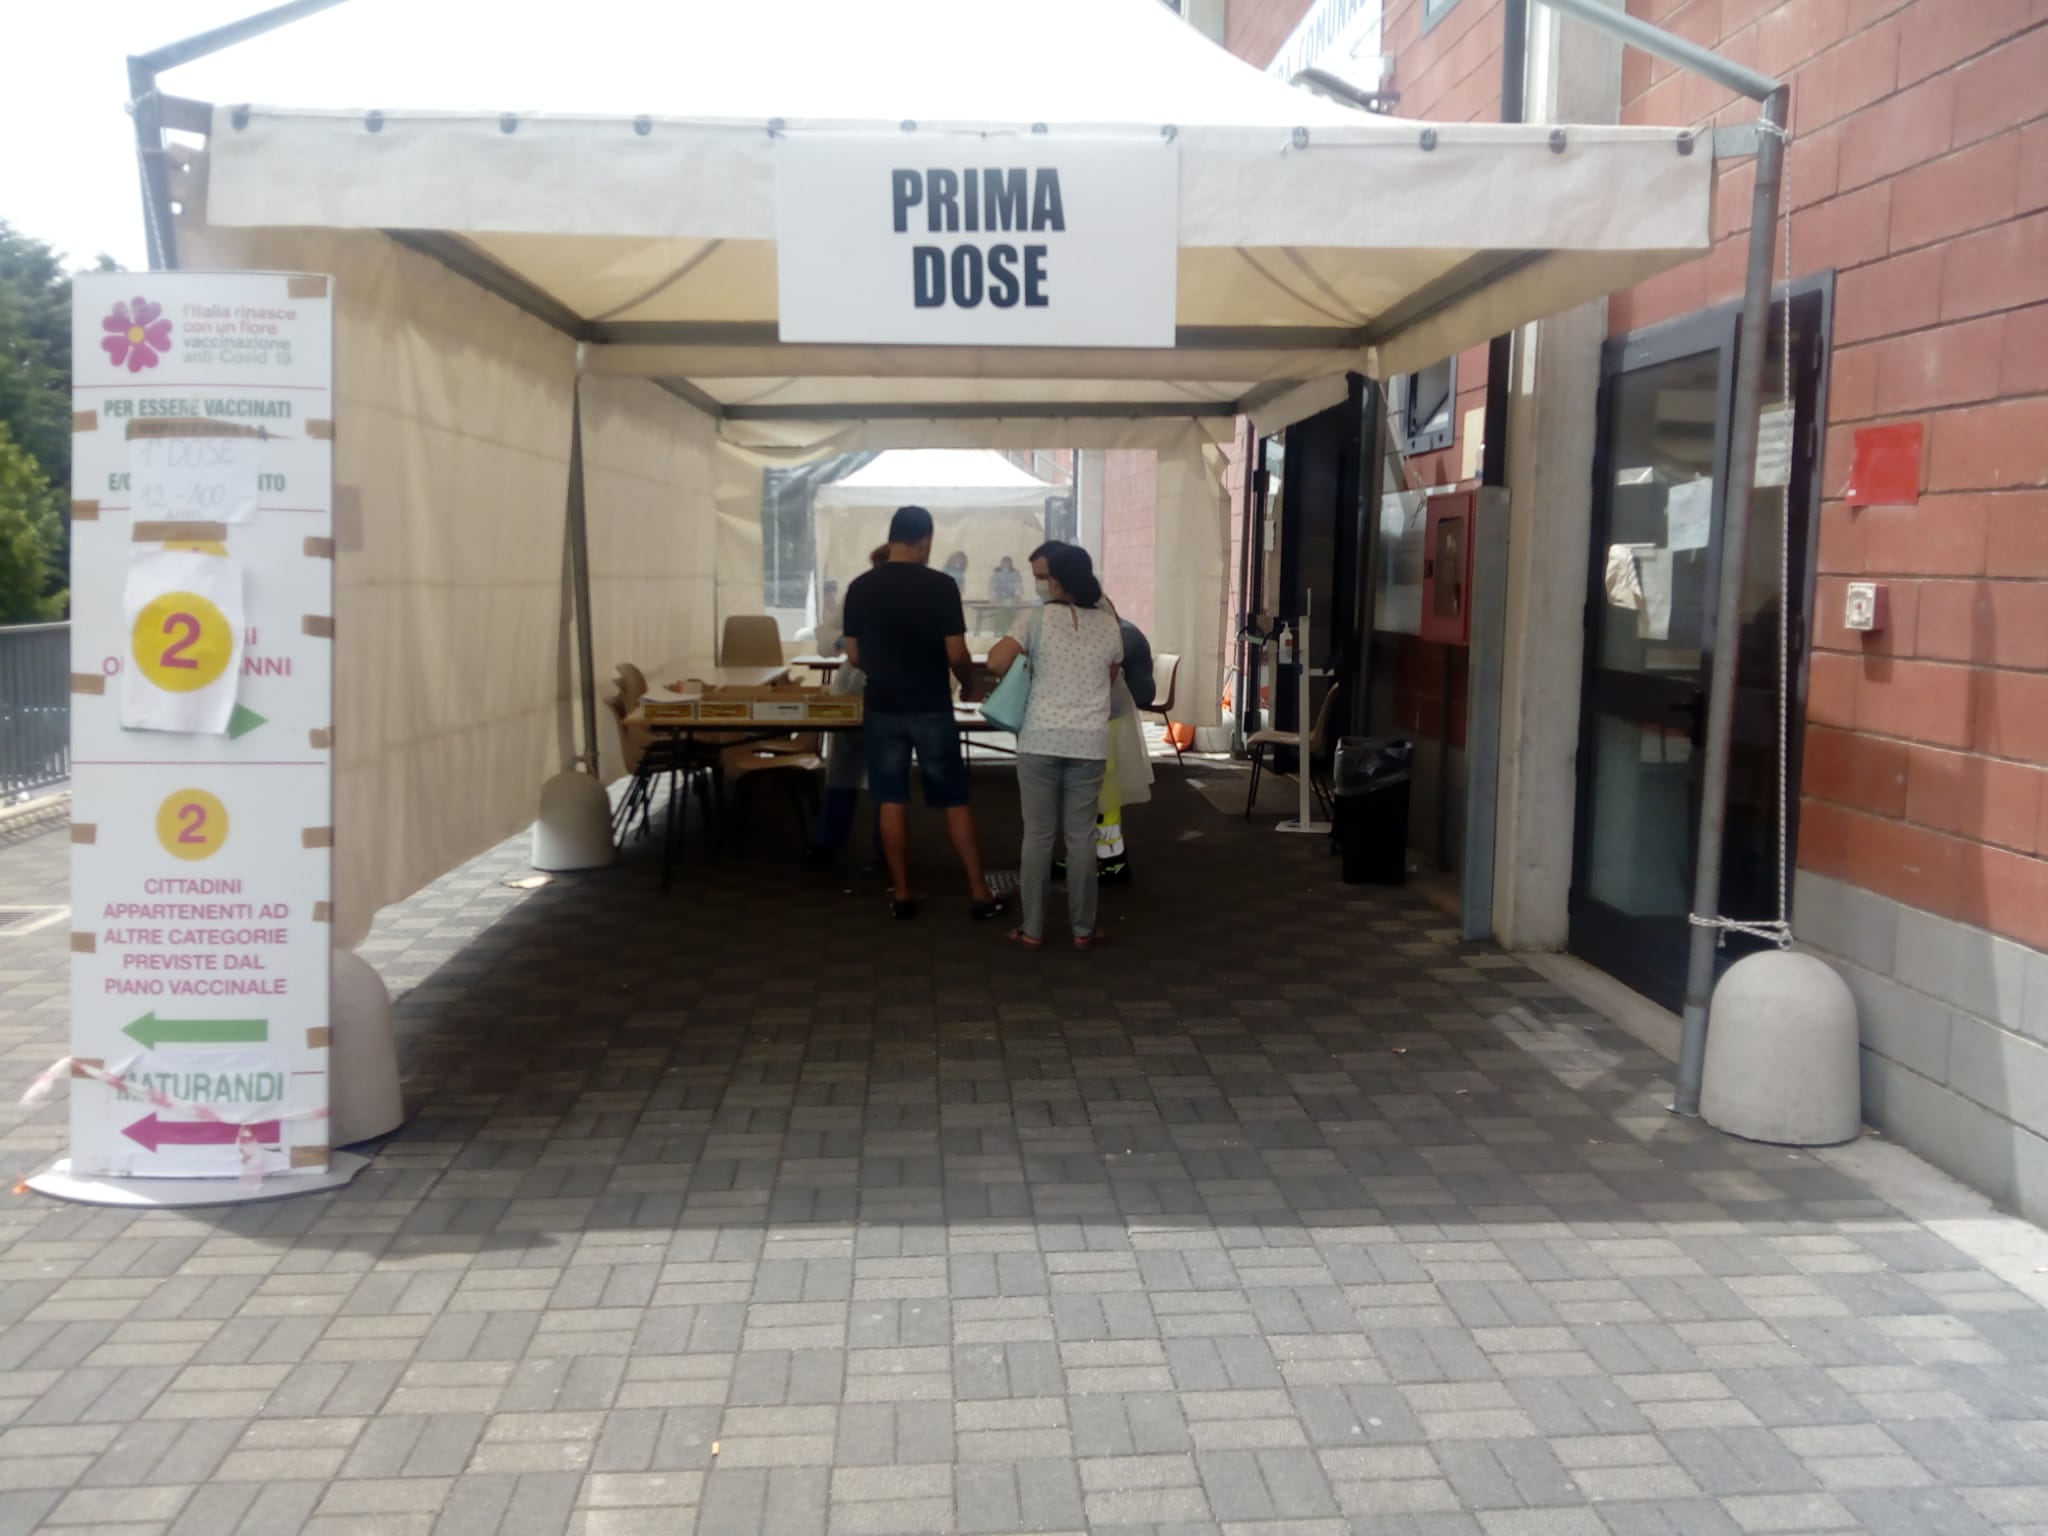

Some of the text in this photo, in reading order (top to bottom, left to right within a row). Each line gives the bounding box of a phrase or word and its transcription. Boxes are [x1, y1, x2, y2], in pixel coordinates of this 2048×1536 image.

[892, 168, 1065, 232] PRIMA
[912, 244, 1049, 308] DOSE
[234, 305, 296, 320] rinasce
[183, 320, 277, 334] con un fiore
[183, 334, 290, 349] vaccinazione
[104, 399, 291, 418] PER ESSERE VACCINATI
[168, 439, 236, 467] DOSE
[159, 612, 202, 670] 2
[177, 803, 207, 844] 2
[144, 878, 242, 895] CITTADINI
[103, 903, 289, 919] APPARTENENTI AD
[104, 929, 288, 945] ALTRE CATEGORIE
[122, 954, 265, 970] PREVISTE DAL
[104, 978, 287, 995] PIANO VACCINALE
